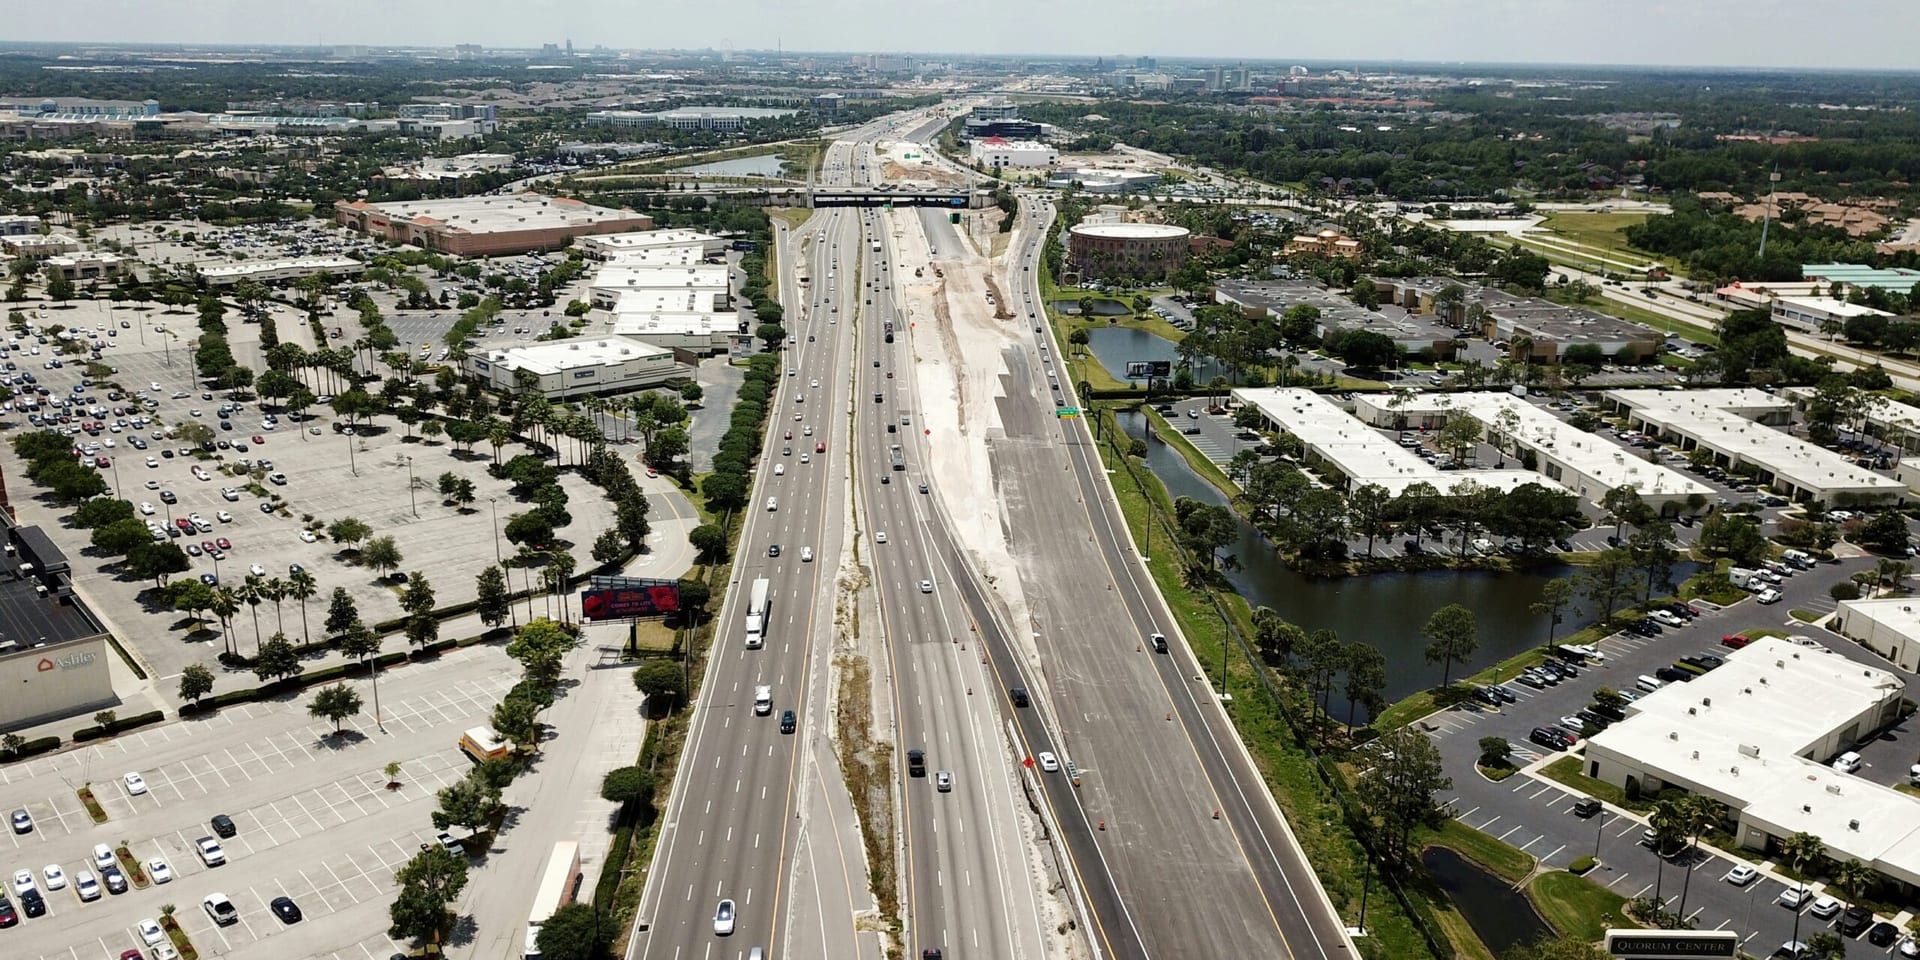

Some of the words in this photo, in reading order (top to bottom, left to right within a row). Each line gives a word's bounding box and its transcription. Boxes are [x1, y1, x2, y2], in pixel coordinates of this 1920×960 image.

[55, 651, 97, 668] Ashley
[1617, 940, 1671, 952] QUORUM
[1675, 941, 1726, 952] CENTER
